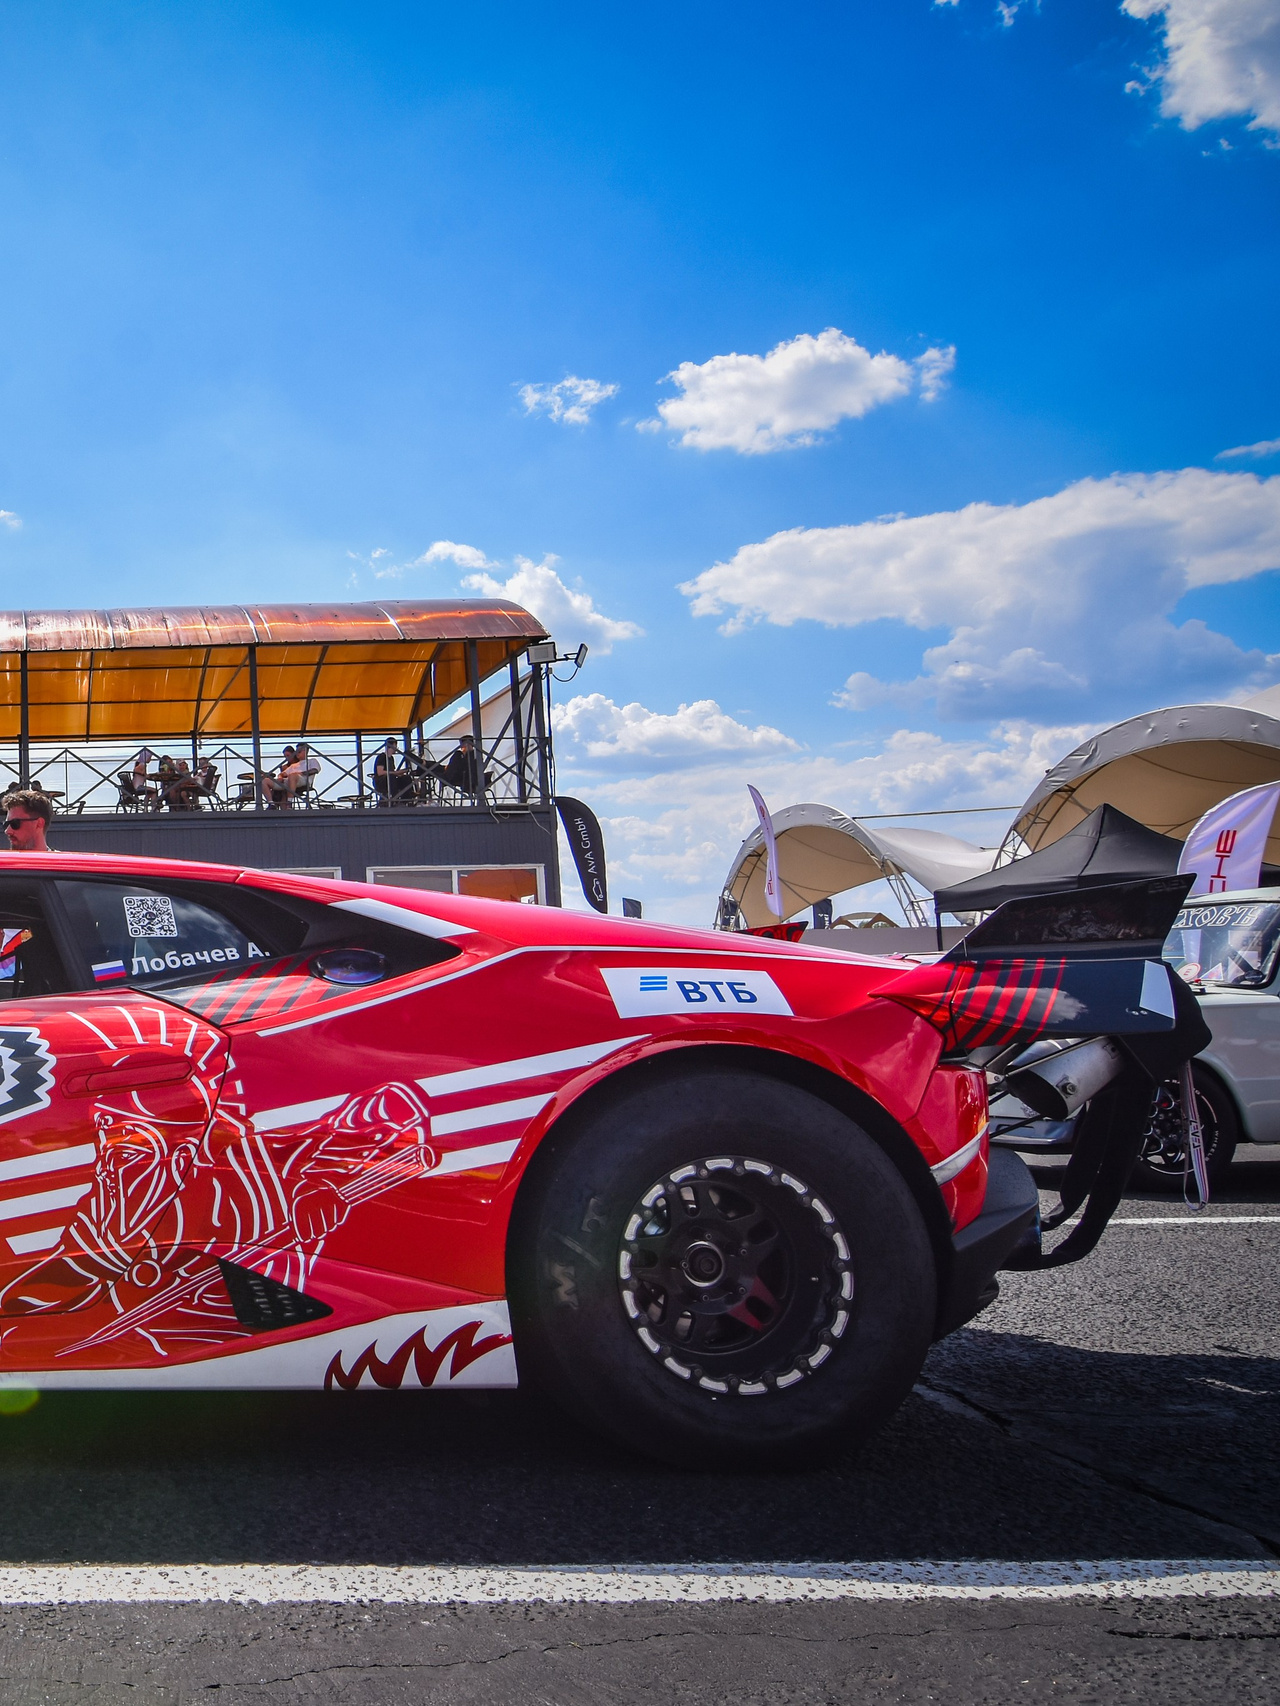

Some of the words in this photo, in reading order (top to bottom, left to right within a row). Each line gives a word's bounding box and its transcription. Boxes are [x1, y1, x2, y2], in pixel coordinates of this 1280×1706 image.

[574, 817, 591, 849] GmbH
[131, 947, 240, 975] Лобачев
[247, 941, 271, 958] А.
[675, 980, 758, 1003] ВТБ
